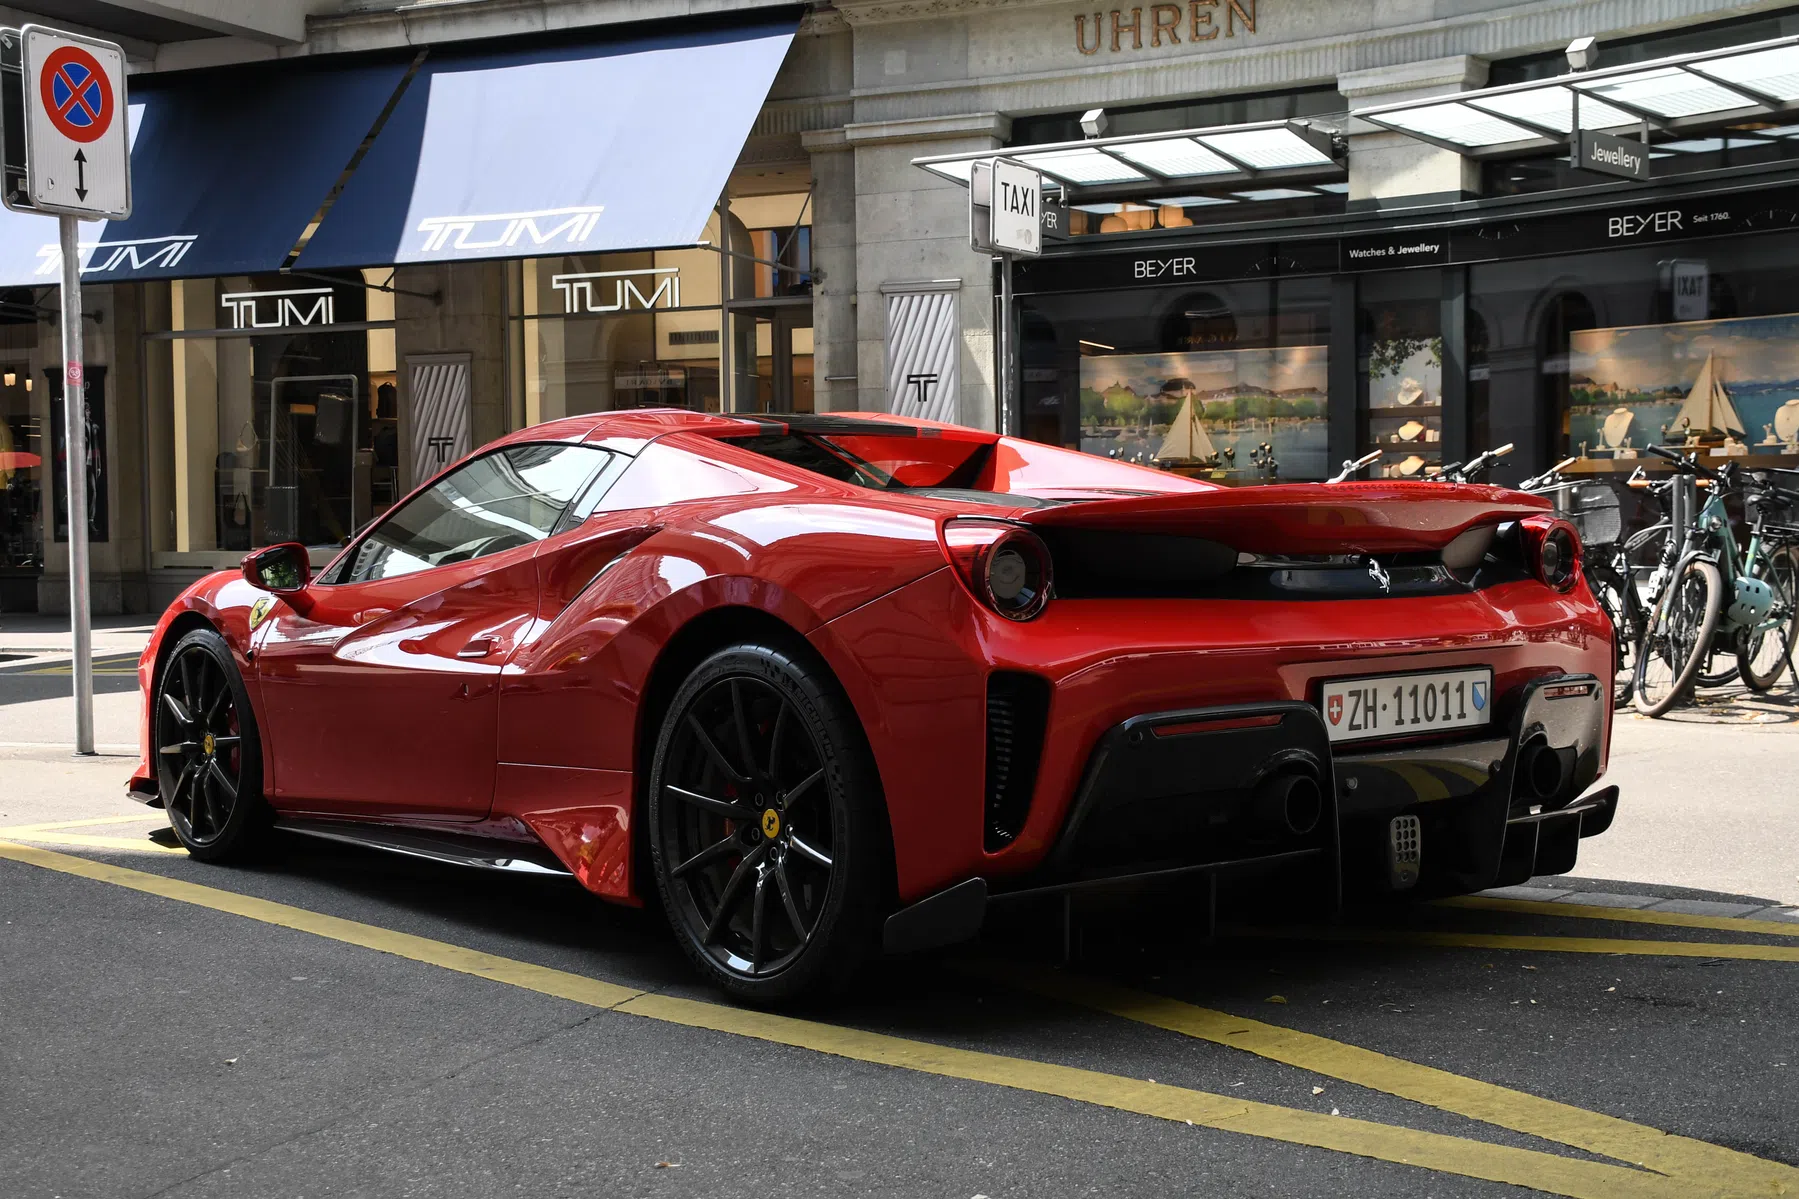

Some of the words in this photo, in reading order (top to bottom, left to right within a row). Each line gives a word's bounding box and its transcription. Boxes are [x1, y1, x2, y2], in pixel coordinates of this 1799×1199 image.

[1075, 0, 1256, 55] UHREN
[1591, 142, 1641, 174] Jewellery
[1001, 182, 1035, 217] TAXI
[417, 206, 605, 251] TUMI
[1041, 211, 1058, 229] YER
[1608, 210, 1683, 237] BEYER
[1693, 214, 1708, 223] Seit
[34, 235, 199, 275] TUMI
[1134, 257, 1197, 278] BEYER
[1349, 248, 1386, 259] Watches
[1388, 246, 1396, 256] &
[1397, 243, 1440, 254] Jewellery
[552, 267, 680, 313] TUMI
[221, 287, 335, 329] TUMI
